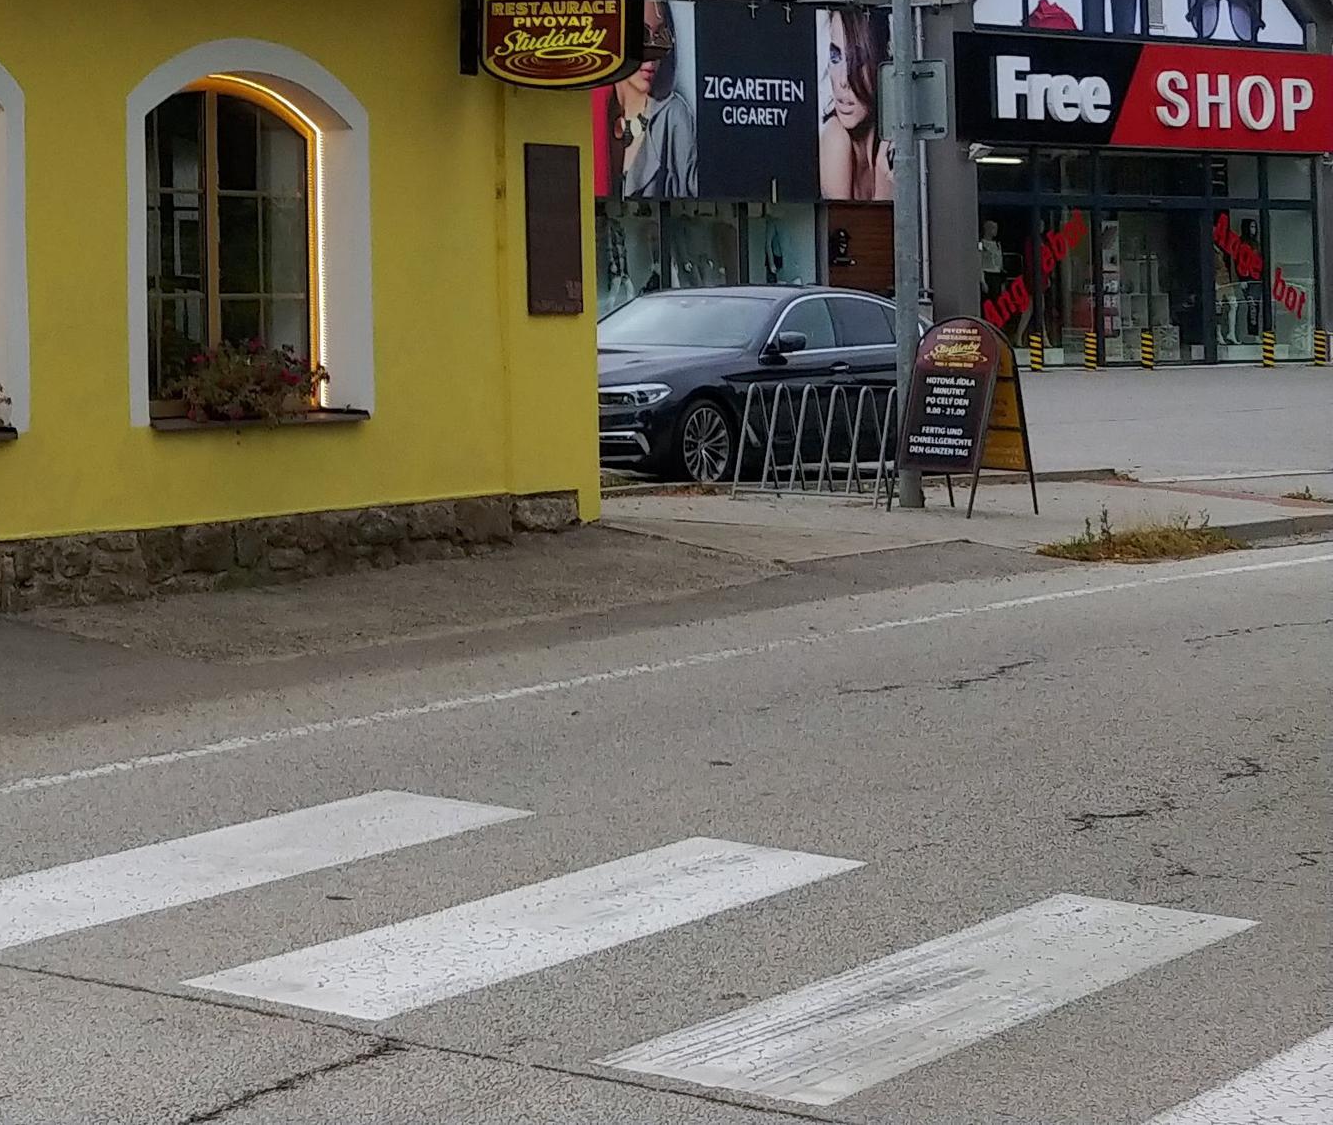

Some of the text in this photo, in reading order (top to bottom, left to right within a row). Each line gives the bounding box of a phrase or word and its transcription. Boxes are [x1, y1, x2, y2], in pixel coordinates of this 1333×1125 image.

[492, 0, 617, 16] RESTAURACE
[513, 16, 594, 27] PIVOVAR
[494, 25, 610, 58] Studánky
[704, 75, 804, 102] ZIGARETTEN
[995, 55, 1314, 132] Free SHOP
[722, 107, 789, 127] CIGARETY
[932, 388, 965, 396] MINUTKY
[954, 398, 969, 406] DEN
[921, 426, 963, 436] FERTIG UND
[909, 446, 925, 454] DEN
[955, 447, 969, 456] TAG
